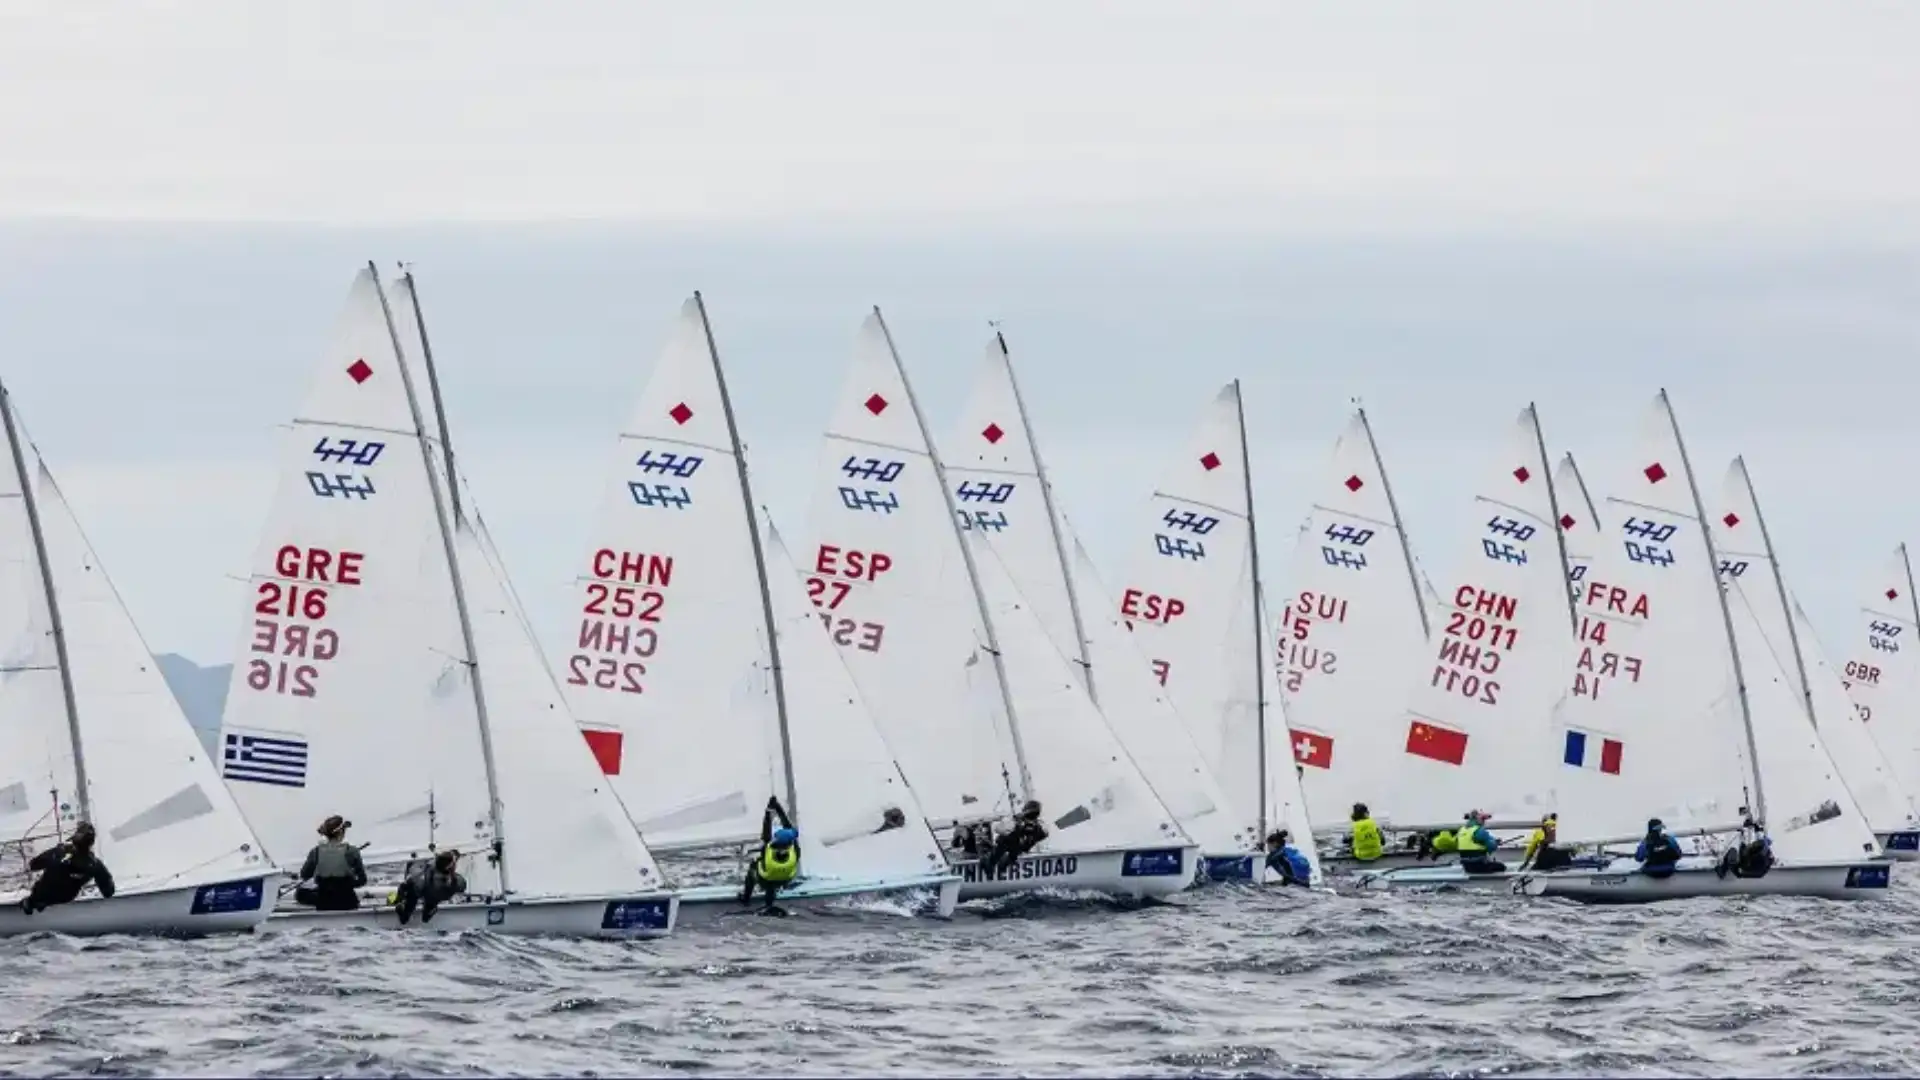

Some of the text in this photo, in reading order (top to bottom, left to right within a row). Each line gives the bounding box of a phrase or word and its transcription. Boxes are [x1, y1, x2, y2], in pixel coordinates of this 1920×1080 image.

[312, 437, 386, 466] 470
[636, 450, 704, 478] 470
[841, 455, 906, 483] 470
[956, 480, 1015, 504] 470
[1162, 508, 1220, 535] 470
[1324, 523, 1375, 547] 470
[1485, 515, 1537, 543] 470
[1622, 516, 1678, 544] 470
[275, 545, 364, 586] GRE
[591, 548, 673, 589] CHN
[814, 544, 892, 583] ESP
[1718, 560, 1749, 578] 70
[255, 581, 328, 620] 216
[582, 582, 666, 624] 252
[806, 576, 854, 610] 27
[1120, 588, 1185, 625] ESP
[1295, 591, 1348, 624] SUI
[1453, 585, 1518, 622] CHN
[1586, 582, 1649, 620] FRA
[1443, 610, 1518, 652] 2011
[1580, 616, 1607, 646] 14
[1869, 620, 1903, 639] 470
[1844, 660, 1881, 685] GBR
